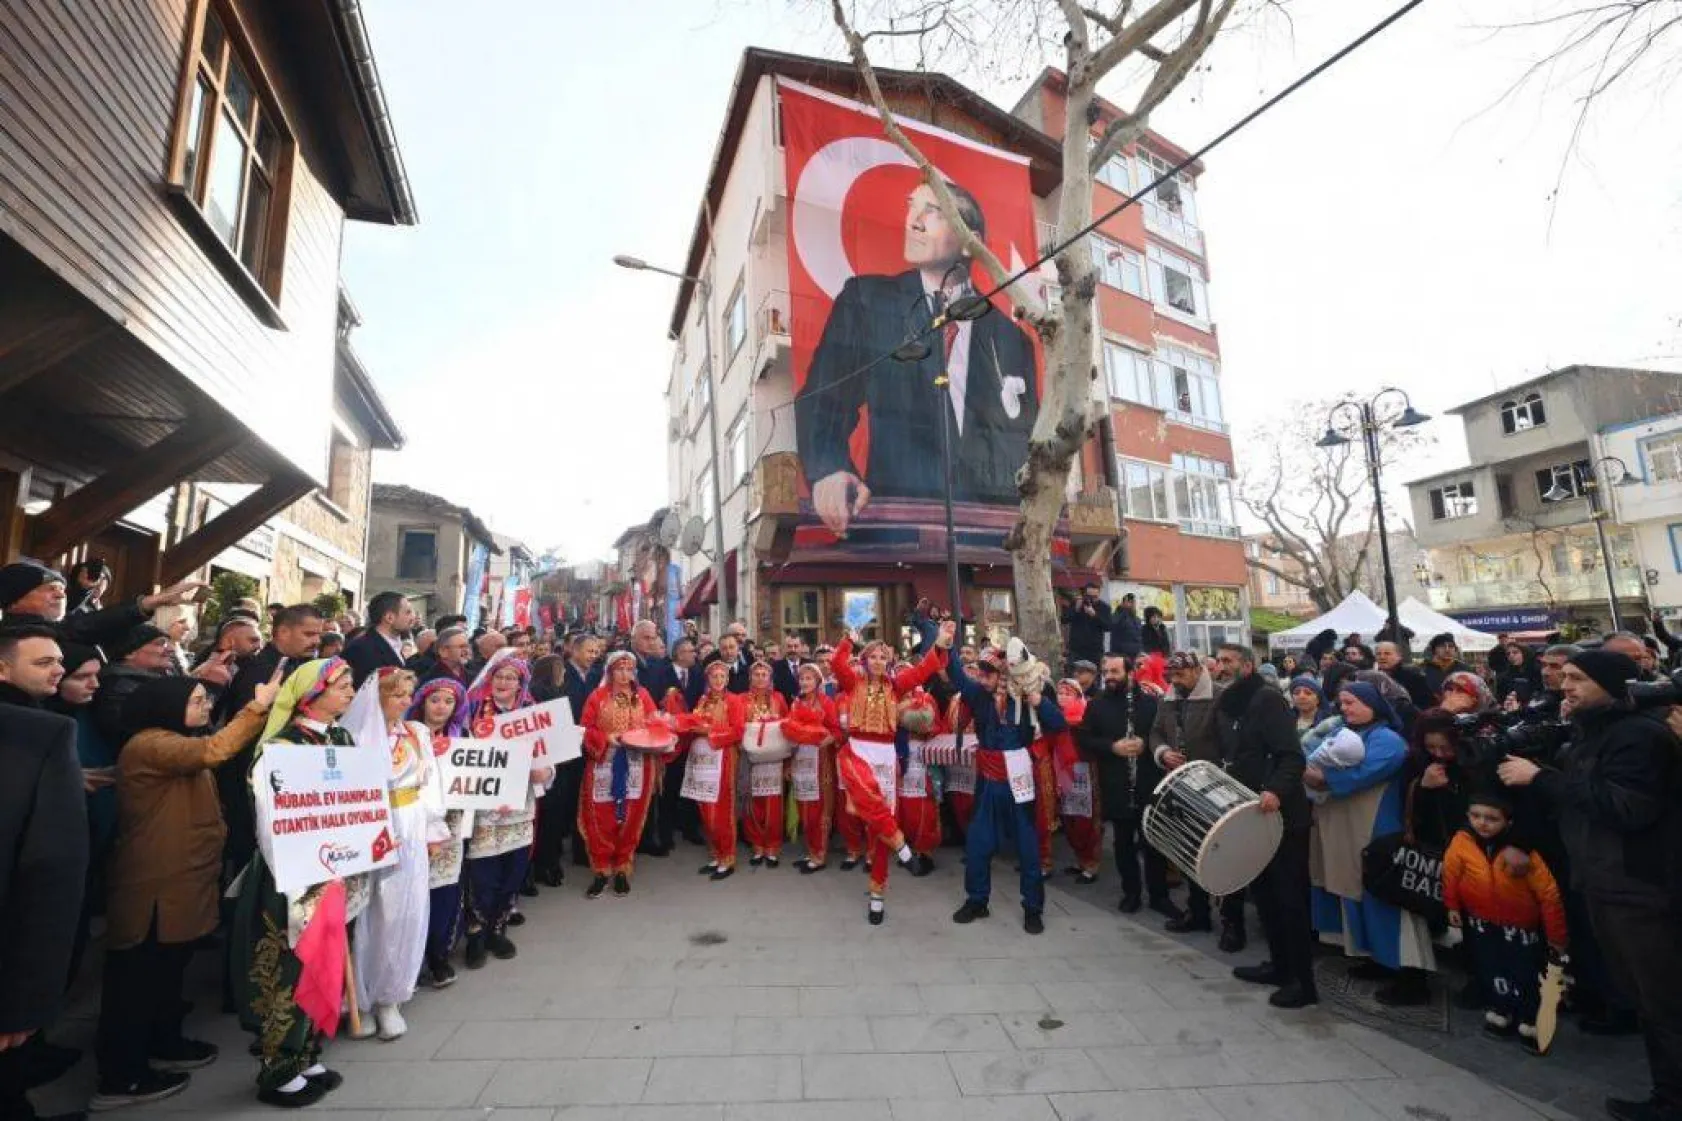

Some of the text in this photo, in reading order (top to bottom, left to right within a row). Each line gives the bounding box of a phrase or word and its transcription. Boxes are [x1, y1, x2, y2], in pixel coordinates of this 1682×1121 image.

[1521, 614, 1548, 624] SHOP
[501, 711, 552, 739] GELİN
[450, 747, 508, 768] GELİN
[448, 776, 501, 796] ALICI
[274, 790, 322, 809] MÜBADİL
[323, 791, 335, 805] EV
[272, 812, 319, 835] OTANTİK
[321, 813, 345, 829] HALK
